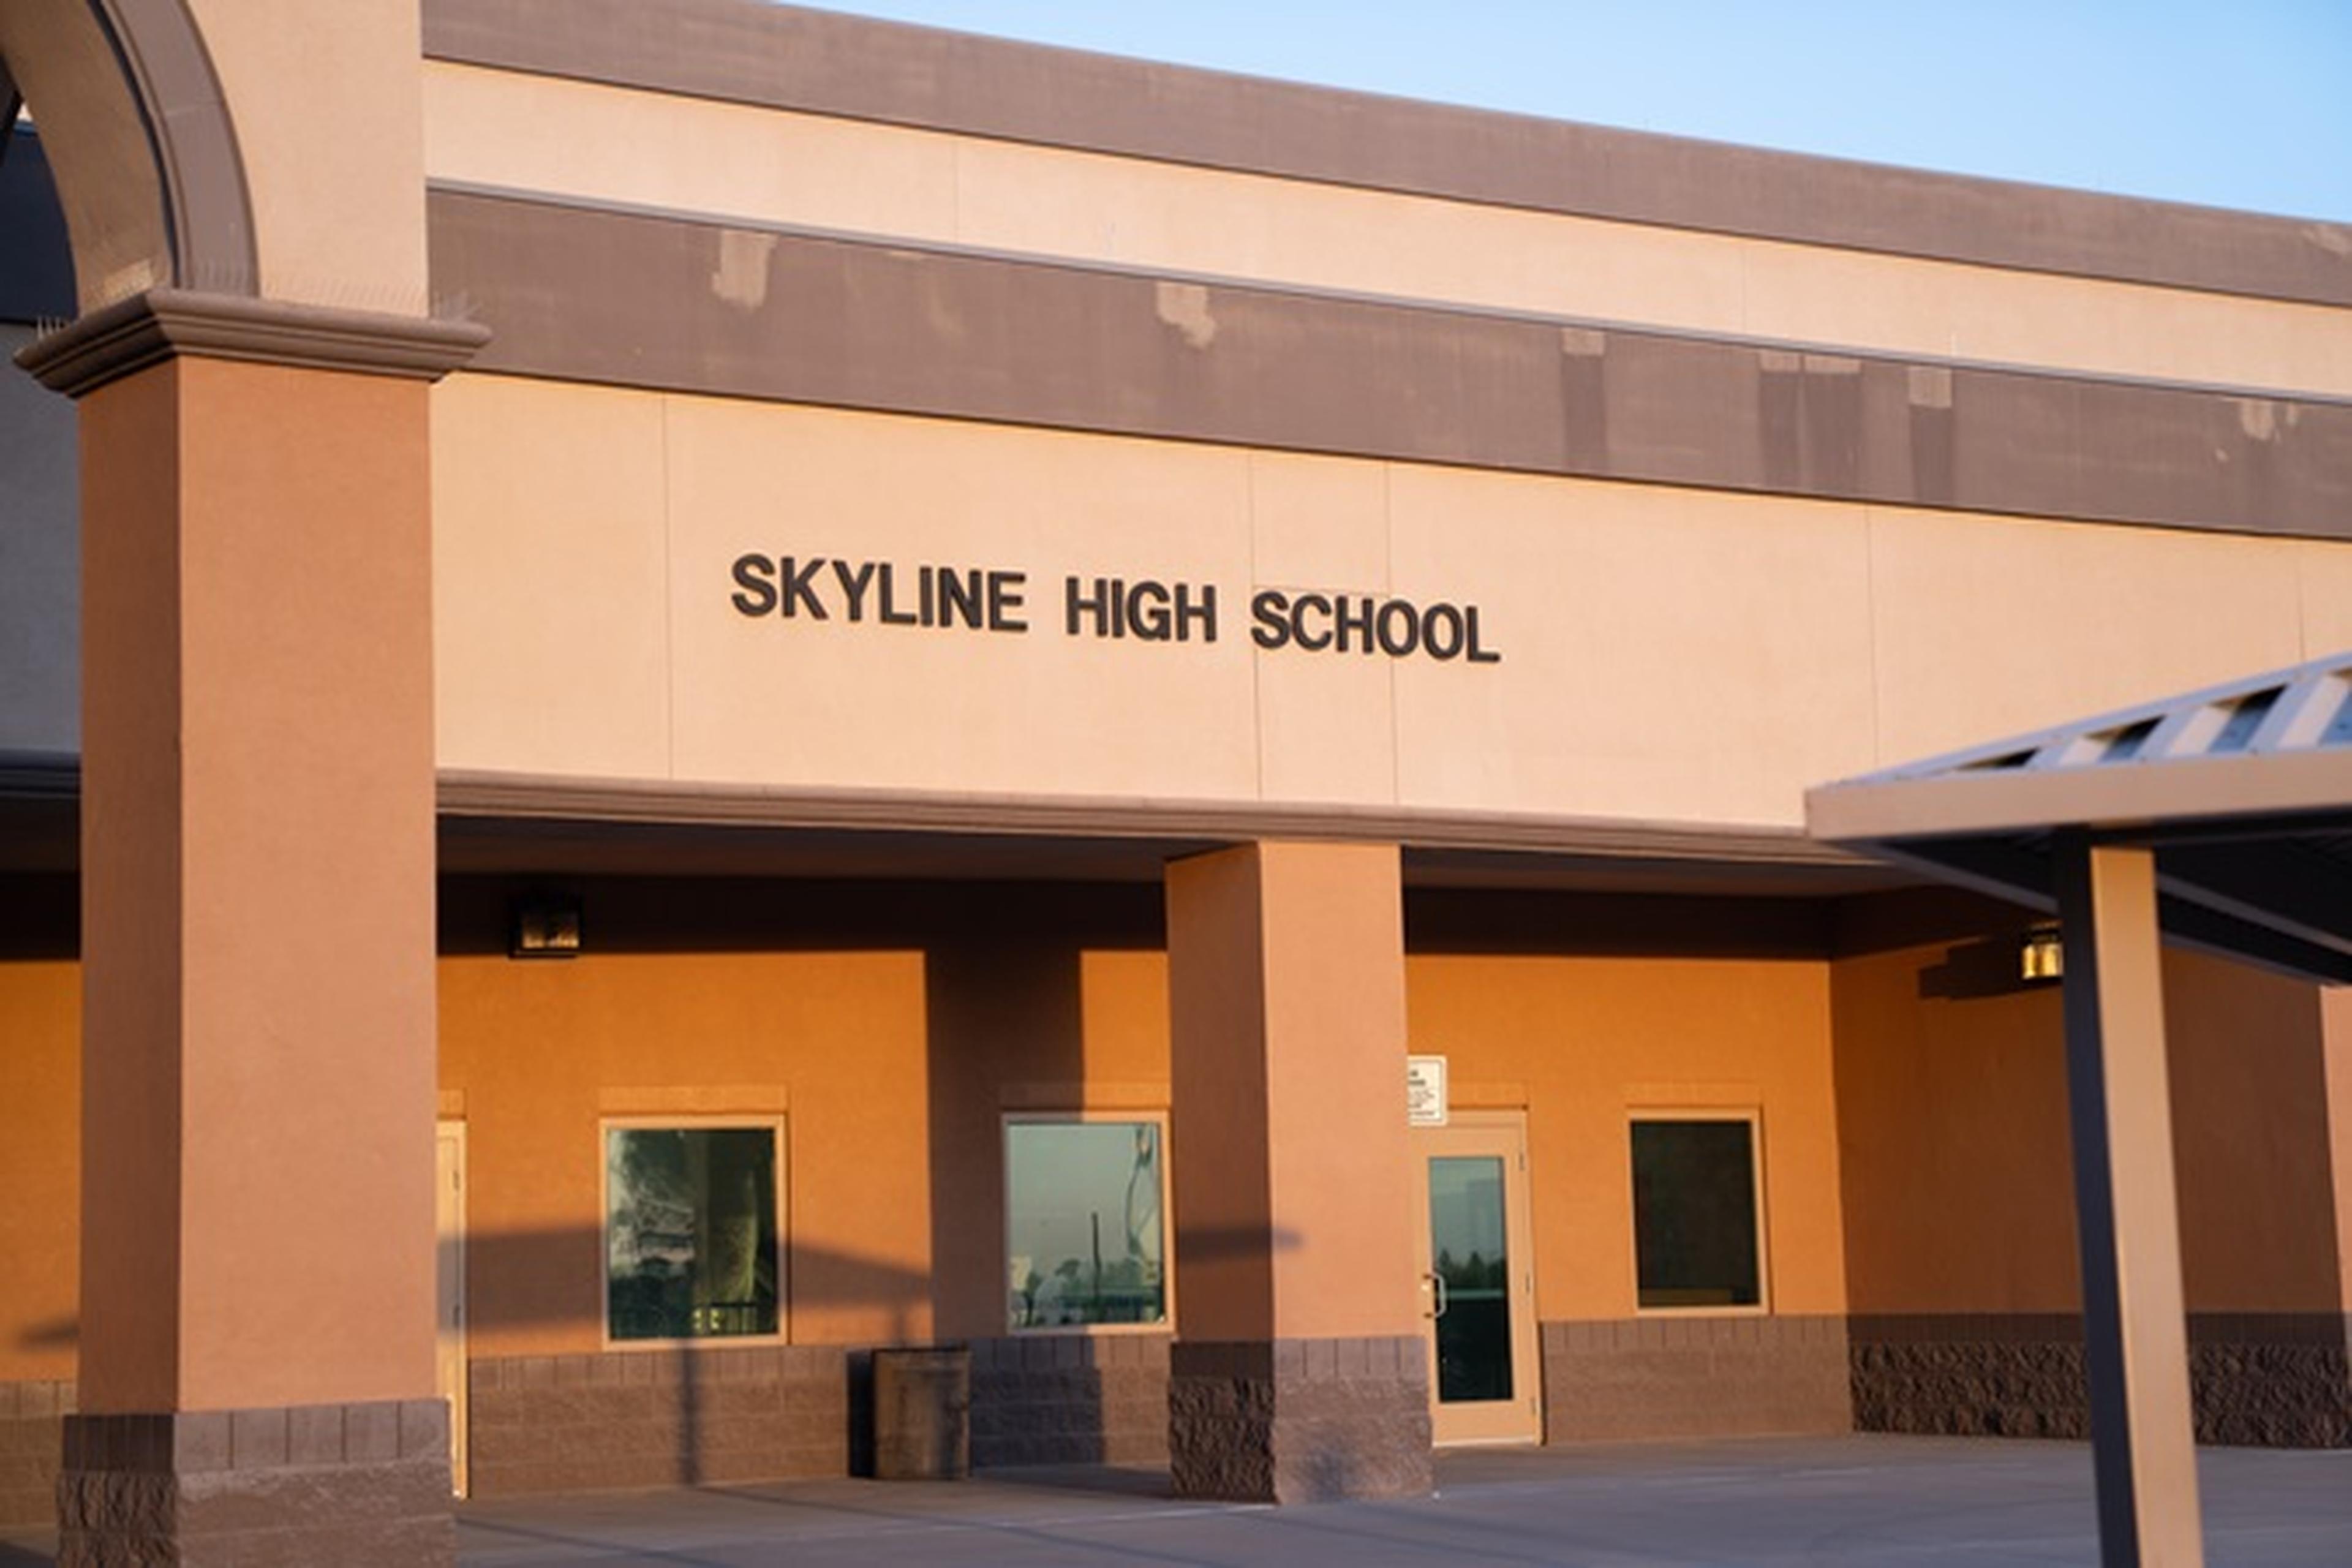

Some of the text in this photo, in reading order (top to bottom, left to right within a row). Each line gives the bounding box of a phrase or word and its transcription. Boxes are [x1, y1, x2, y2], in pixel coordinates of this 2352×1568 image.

[731, 554, 1501, 663] SKYLINE HIGH SCHOOL
